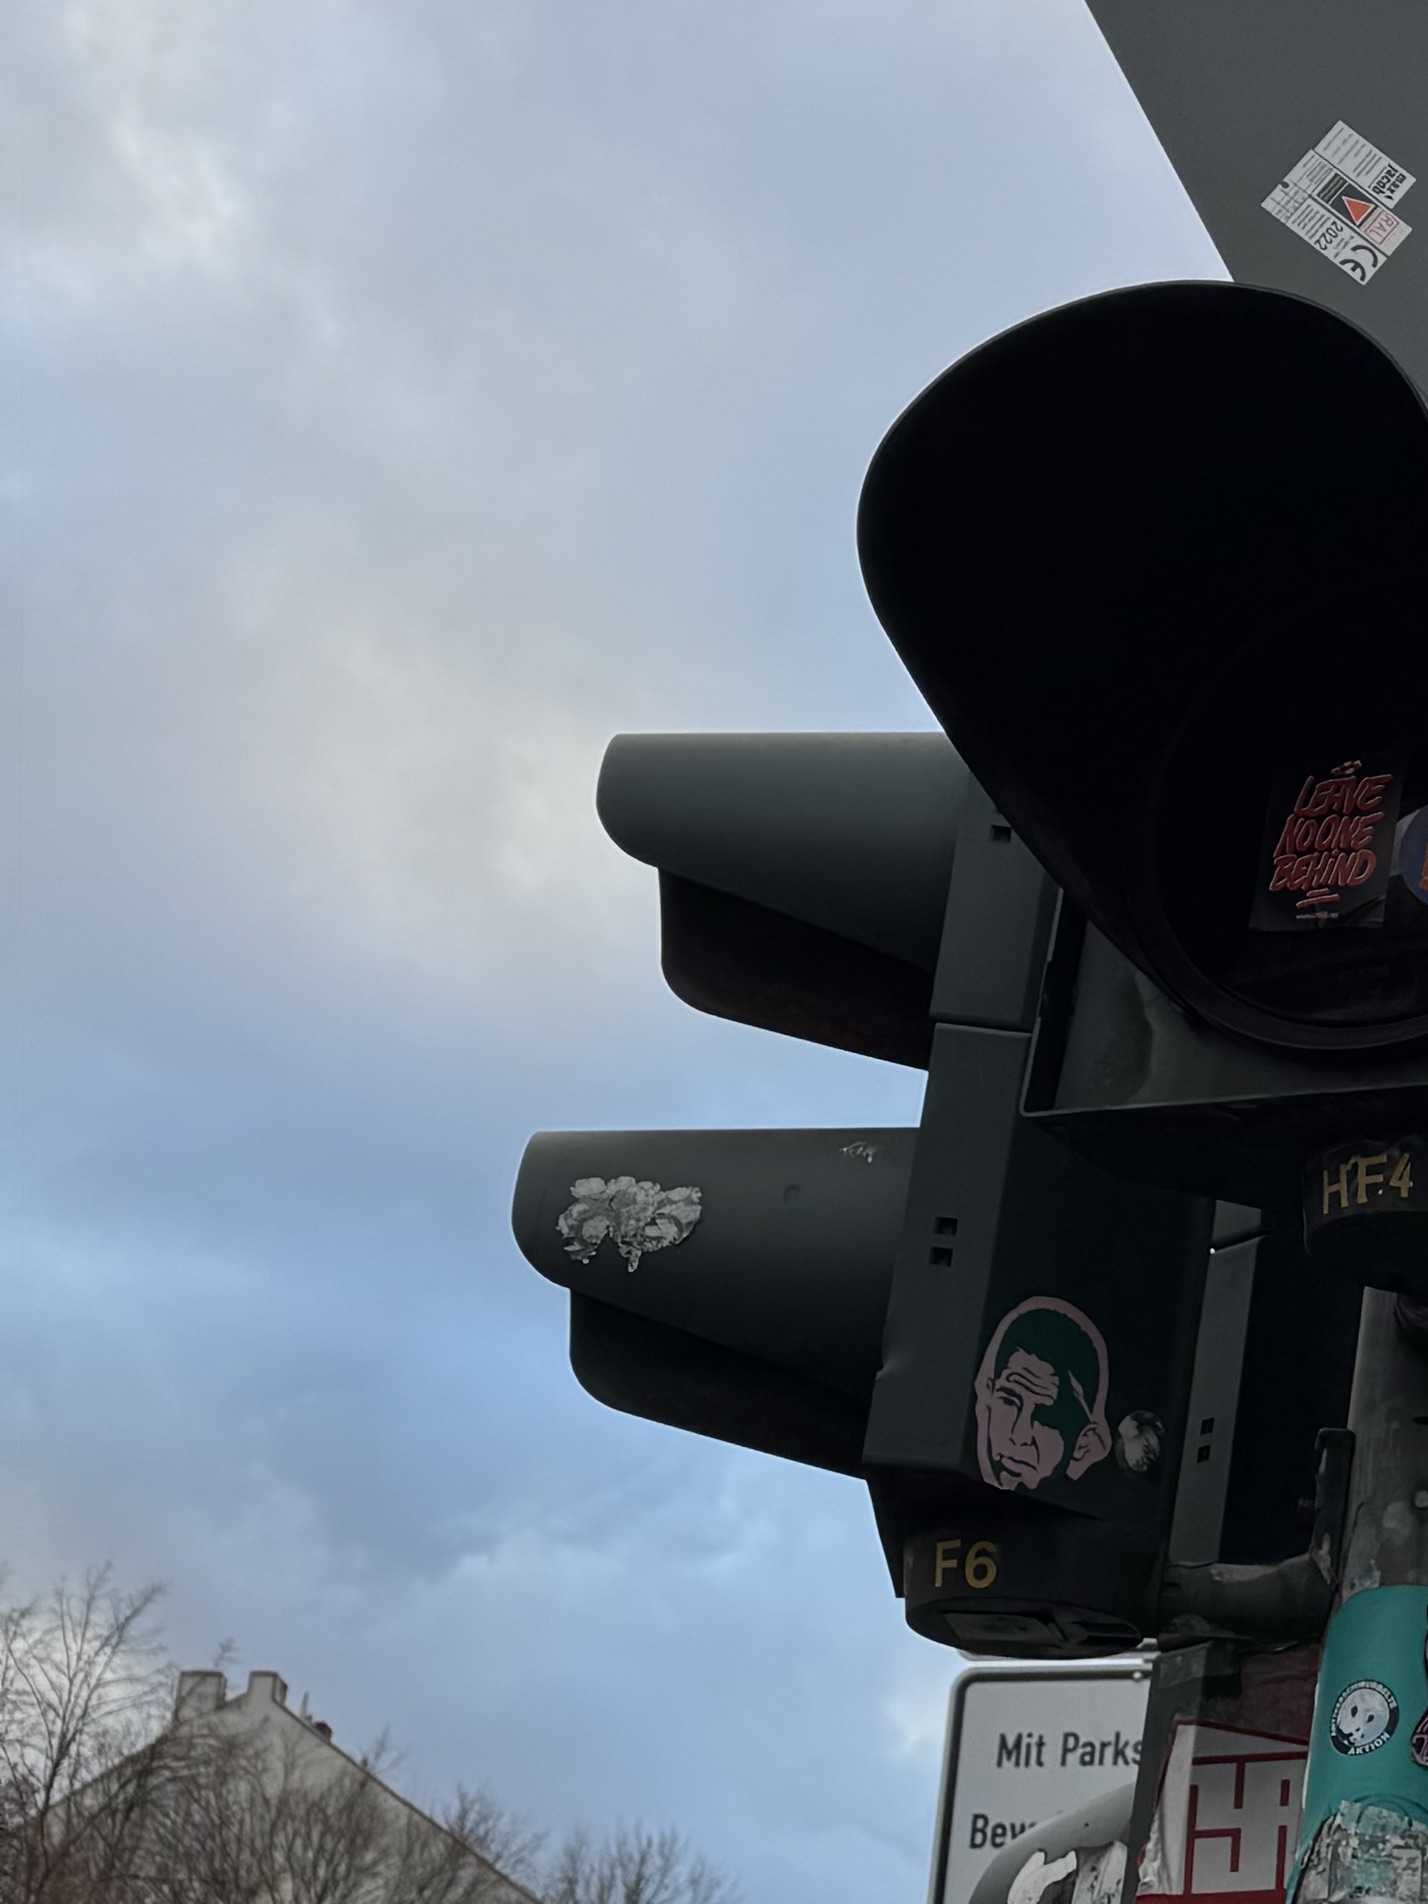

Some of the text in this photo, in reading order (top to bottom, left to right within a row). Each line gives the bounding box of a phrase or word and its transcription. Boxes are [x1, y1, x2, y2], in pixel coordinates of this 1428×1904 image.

[1314, 220, 1344, 251] 2022
[1368, 212, 1396, 241] RAL
[1294, 774, 1393, 817] LEAVE
[1322, 1153, 1414, 1215] HF4
[934, 1539, 998, 1589] F6
[996, 1731, 1046, 1769] Mit
